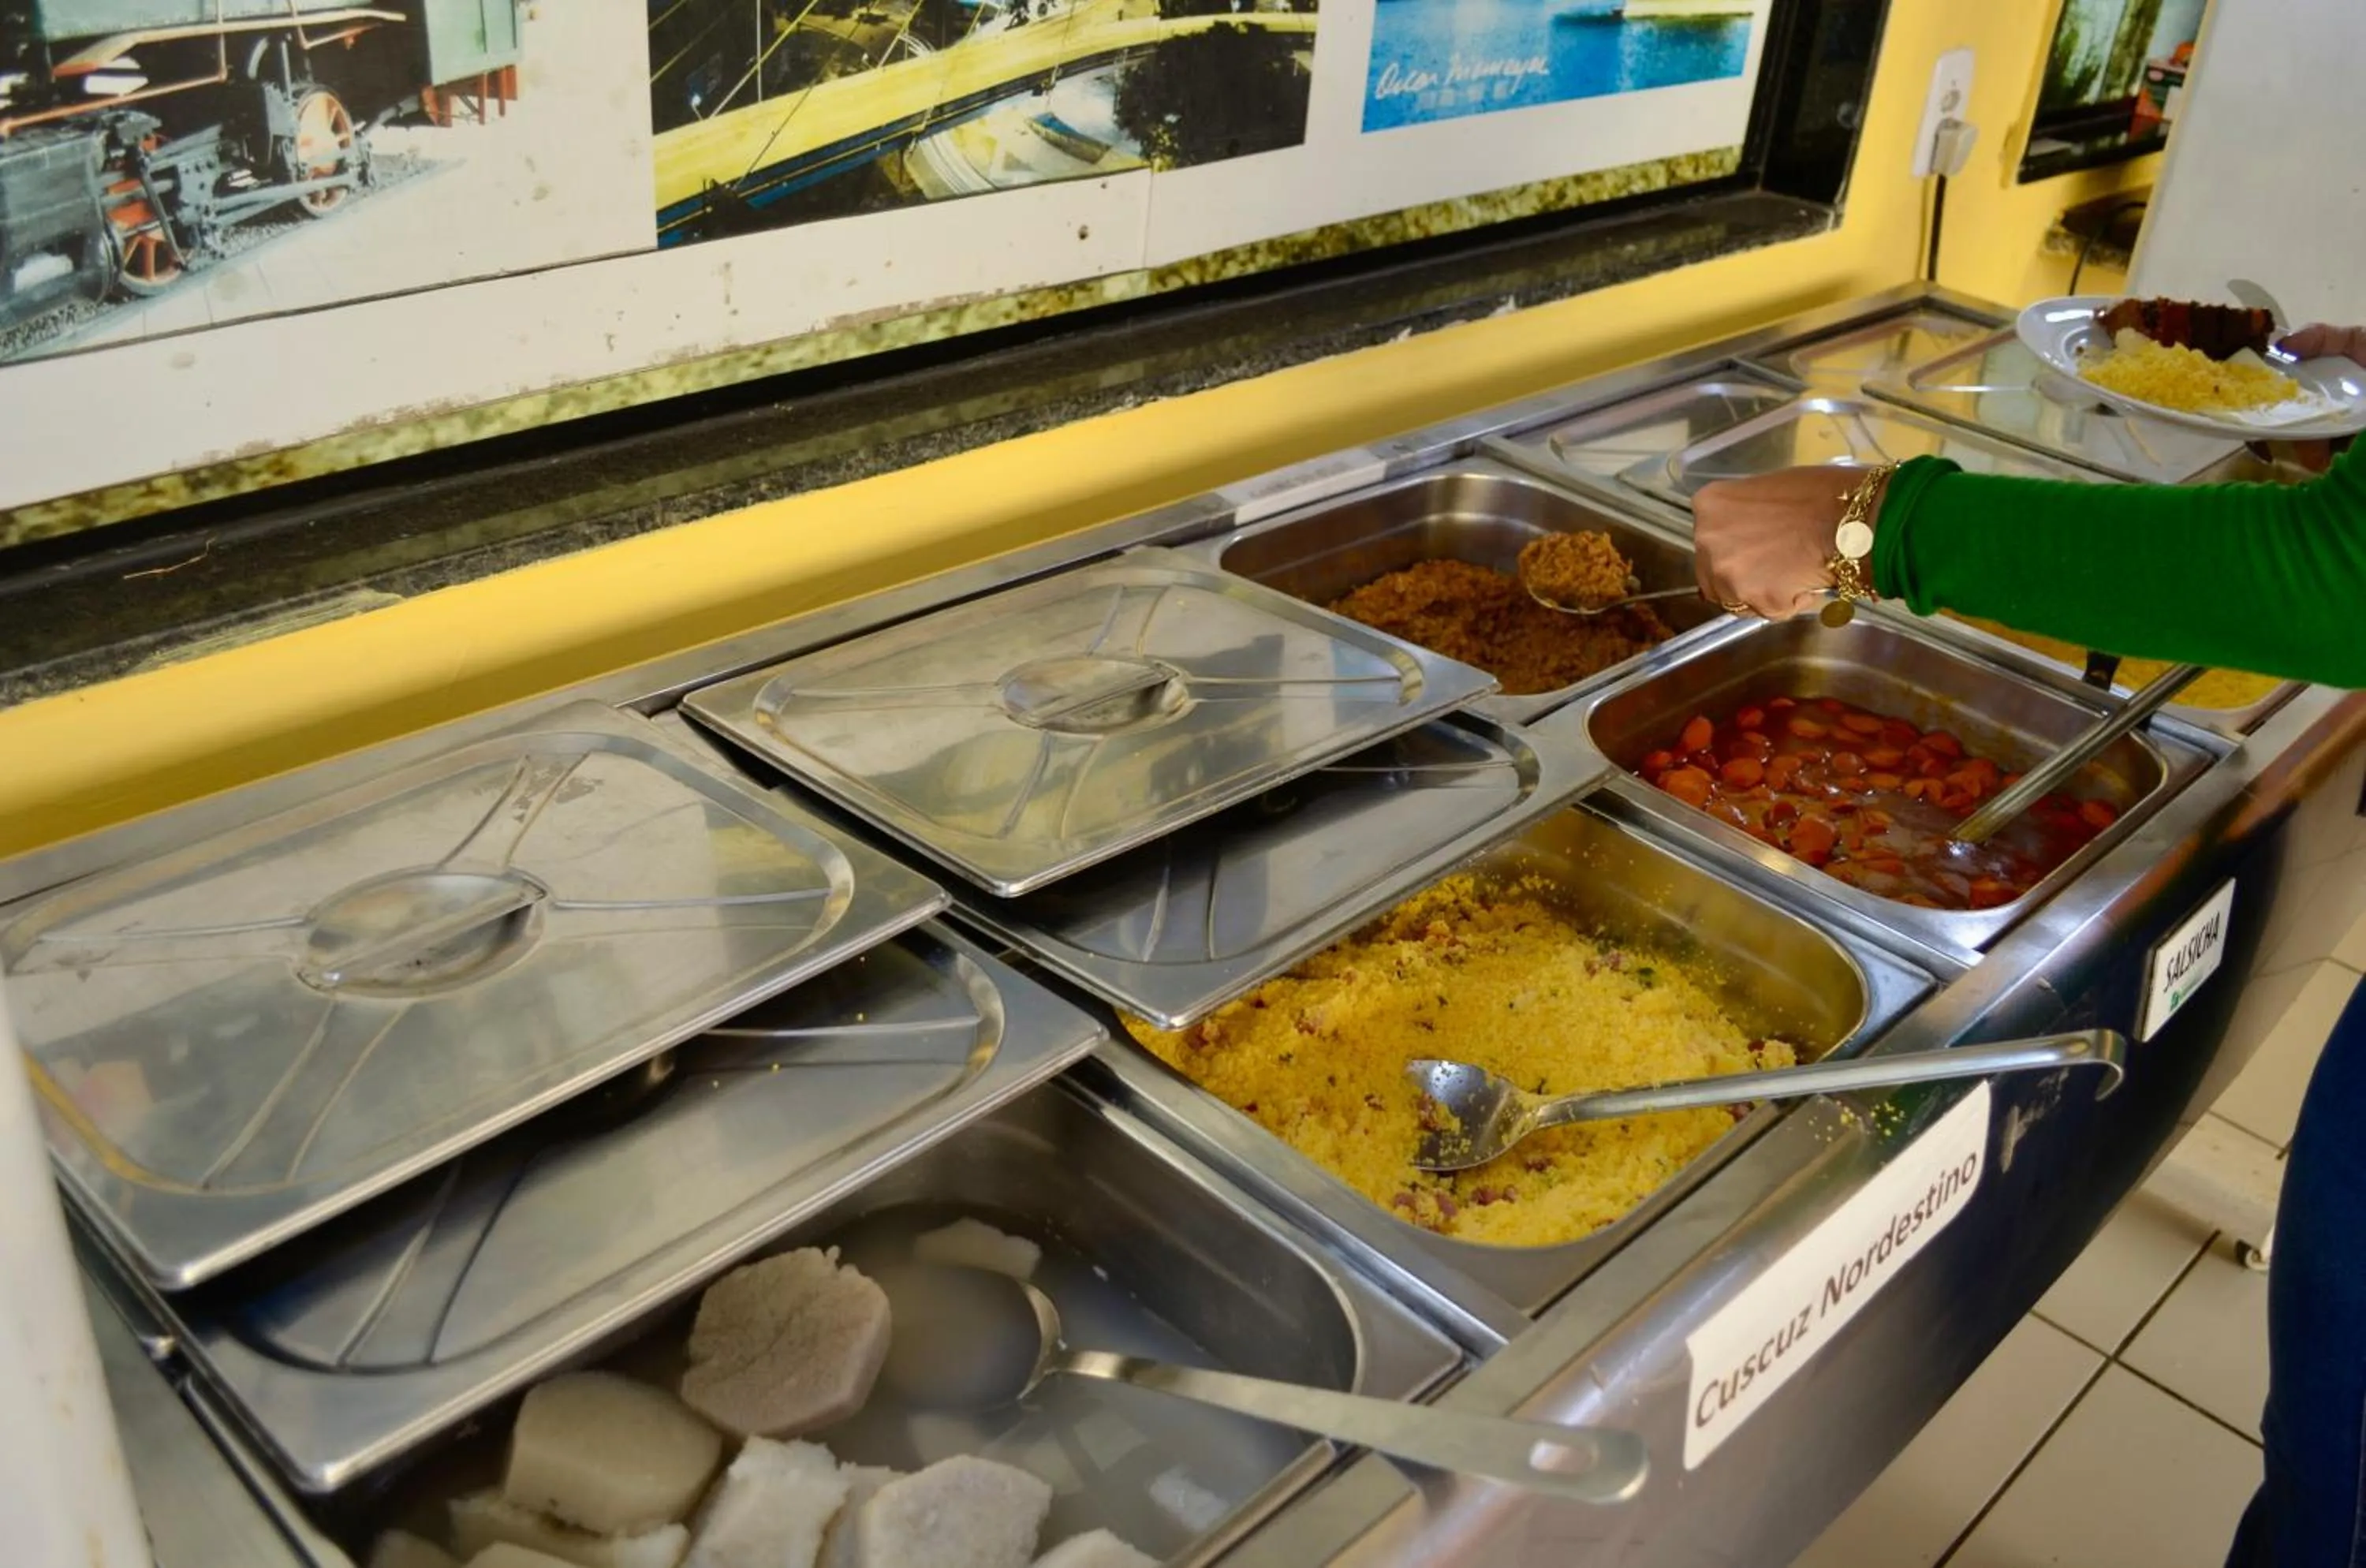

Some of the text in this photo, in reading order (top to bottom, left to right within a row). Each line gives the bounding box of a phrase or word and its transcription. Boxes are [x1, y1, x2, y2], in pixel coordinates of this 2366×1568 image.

[2163, 910, 2221, 993] SALSICHA
[1694, 1152, 1977, 1429] Cuscuz Nordestino
